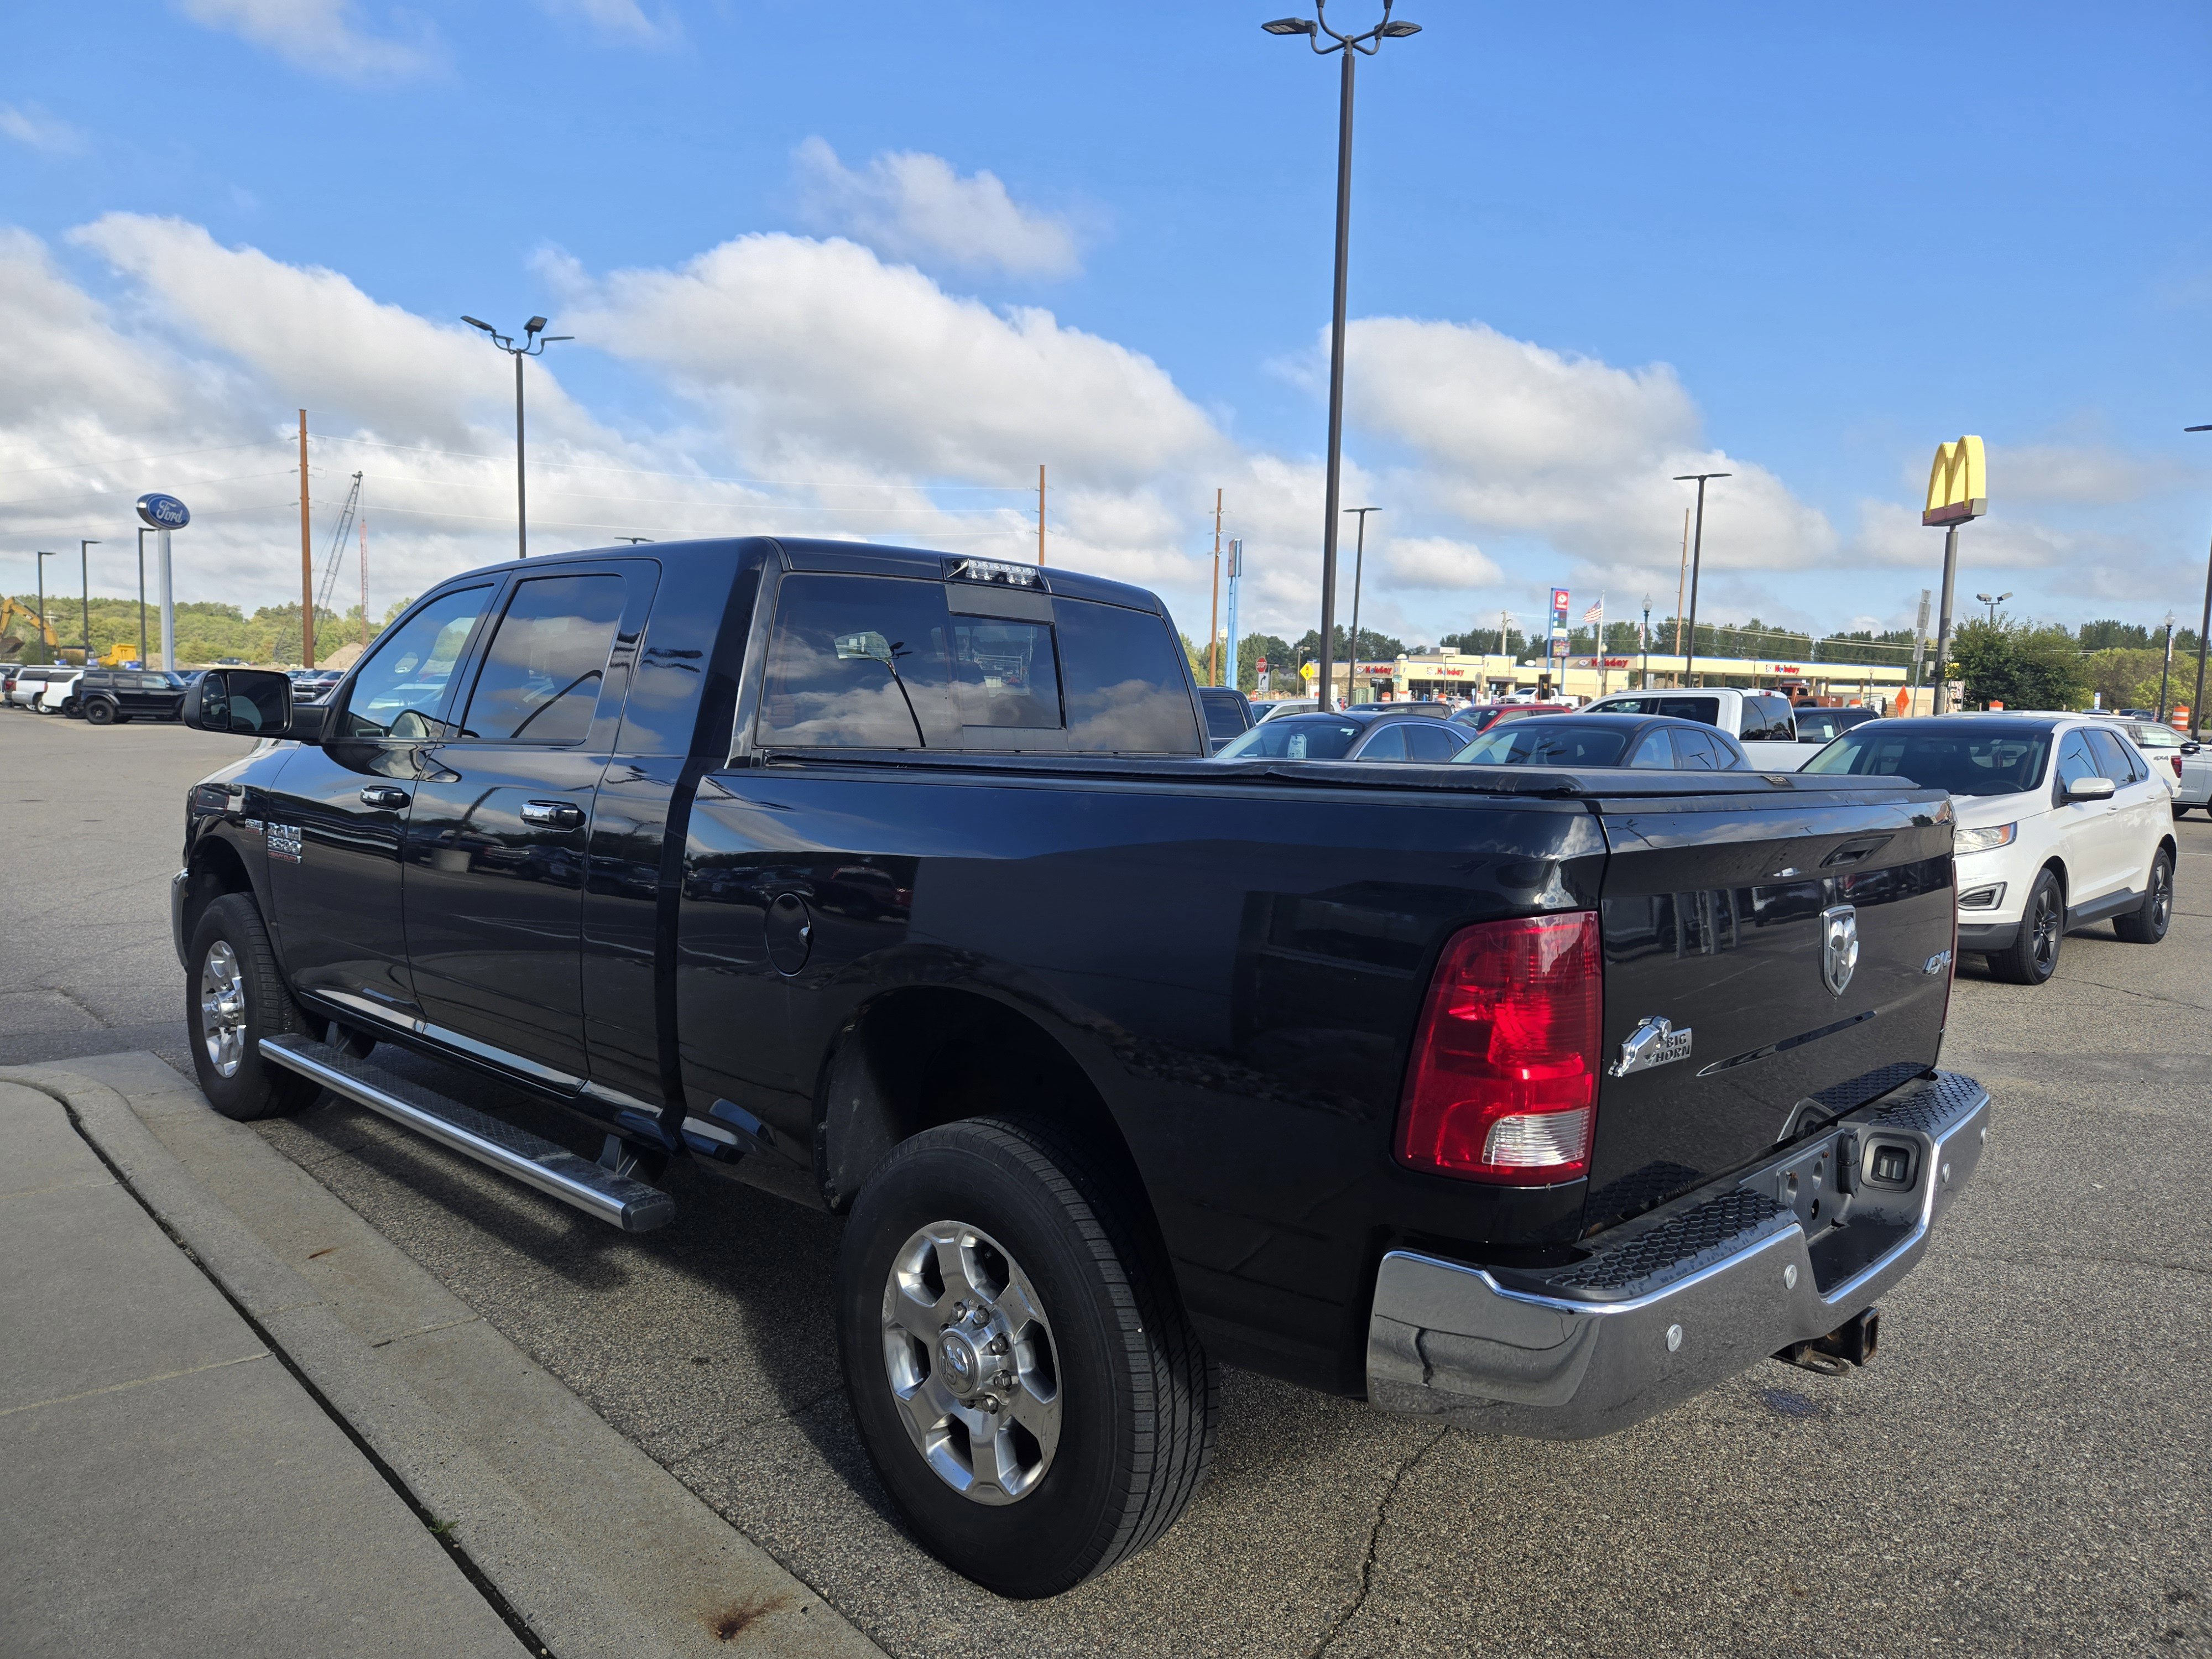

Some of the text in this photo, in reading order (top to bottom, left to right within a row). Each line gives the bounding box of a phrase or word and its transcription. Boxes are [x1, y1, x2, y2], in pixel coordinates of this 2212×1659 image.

[156, 500, 183, 523] Ford
[1591, 658, 1629, 668] Hliday
[1365, 666, 1392, 675] Holiday
[268, 822, 301, 841] RAM
[284, 854, 297, 863] DUTY
[1666, 1034, 1687, 1048] BIG
[1655, 1045, 1691, 1063] HORN
